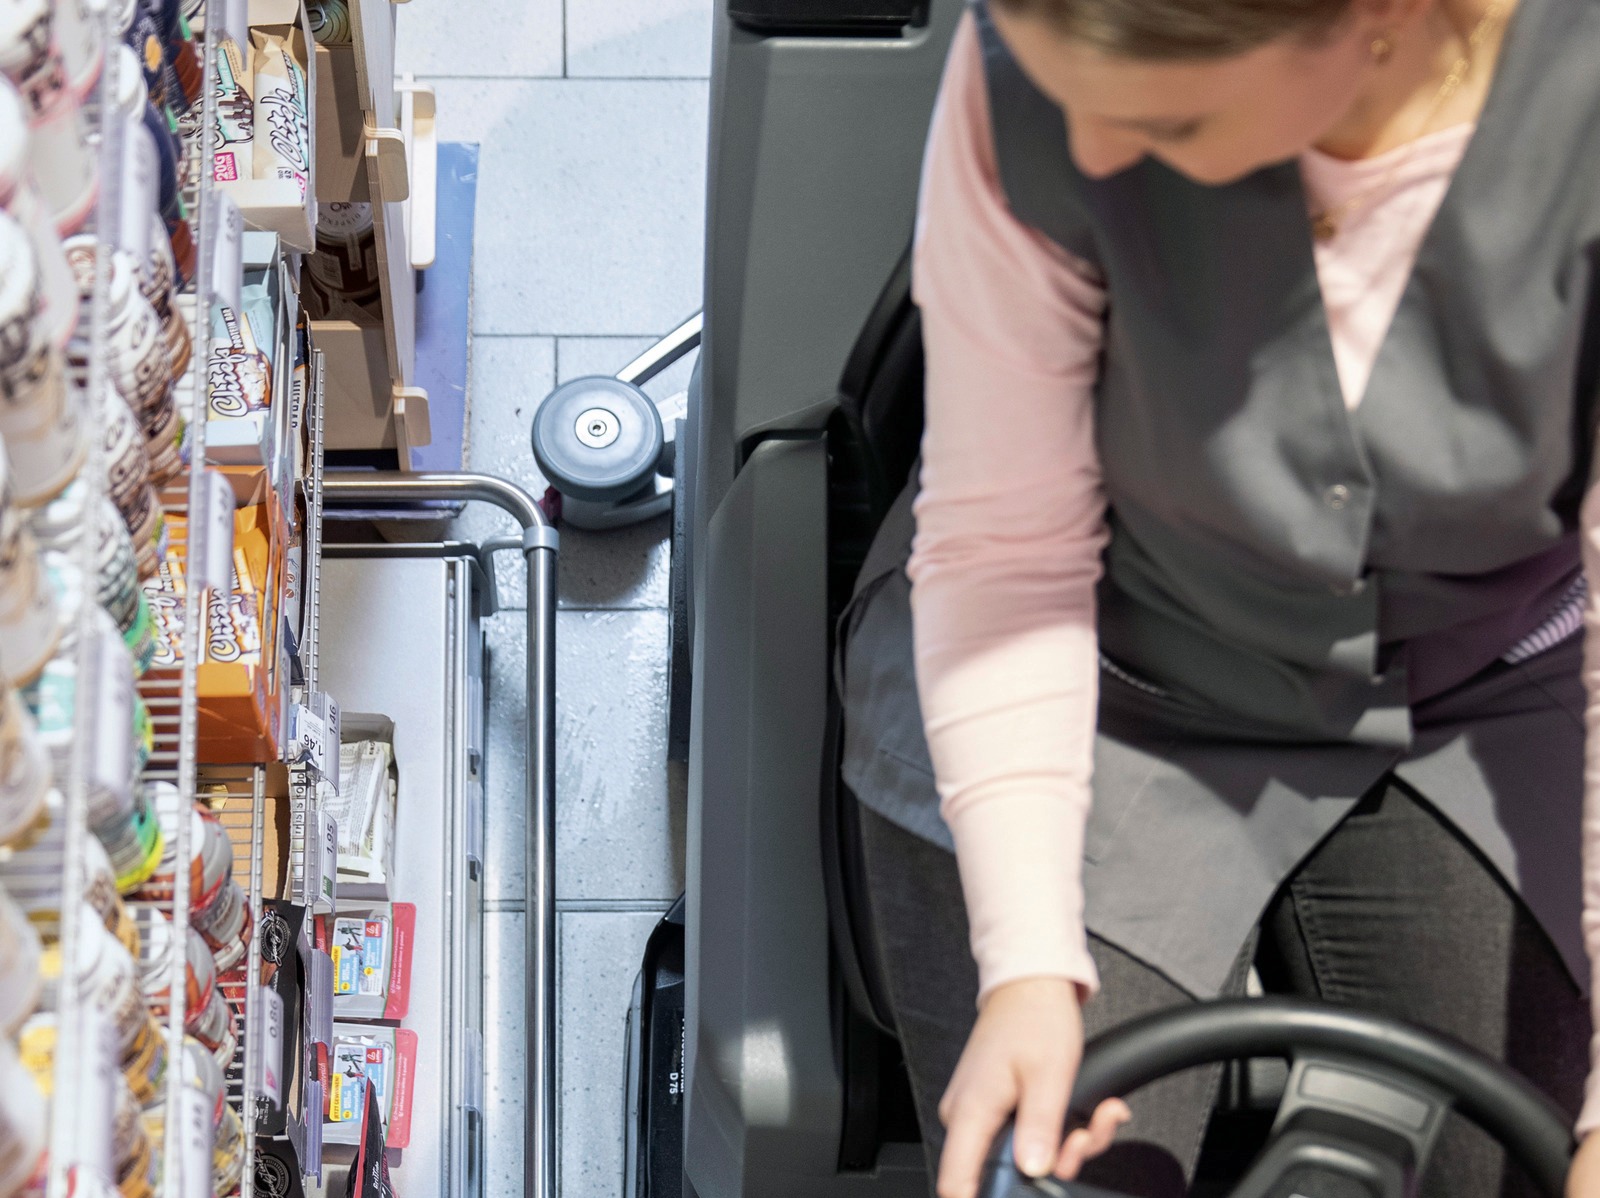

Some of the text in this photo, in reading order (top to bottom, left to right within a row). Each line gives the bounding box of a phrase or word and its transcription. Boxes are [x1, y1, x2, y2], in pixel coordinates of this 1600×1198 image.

[214, 155, 229, 180] 20G
[226, 154, 237, 180] PROTEIN
[221, 308, 243, 348] PROTEIN BAR
[329, 704, 337, 735] 1,46
[303, 733, 323, 756] 1,46
[326, 823, 334, 855] 1,95
[269, 999, 279, 1039] 0,86
[669, 1072, 679, 1094] D 75
